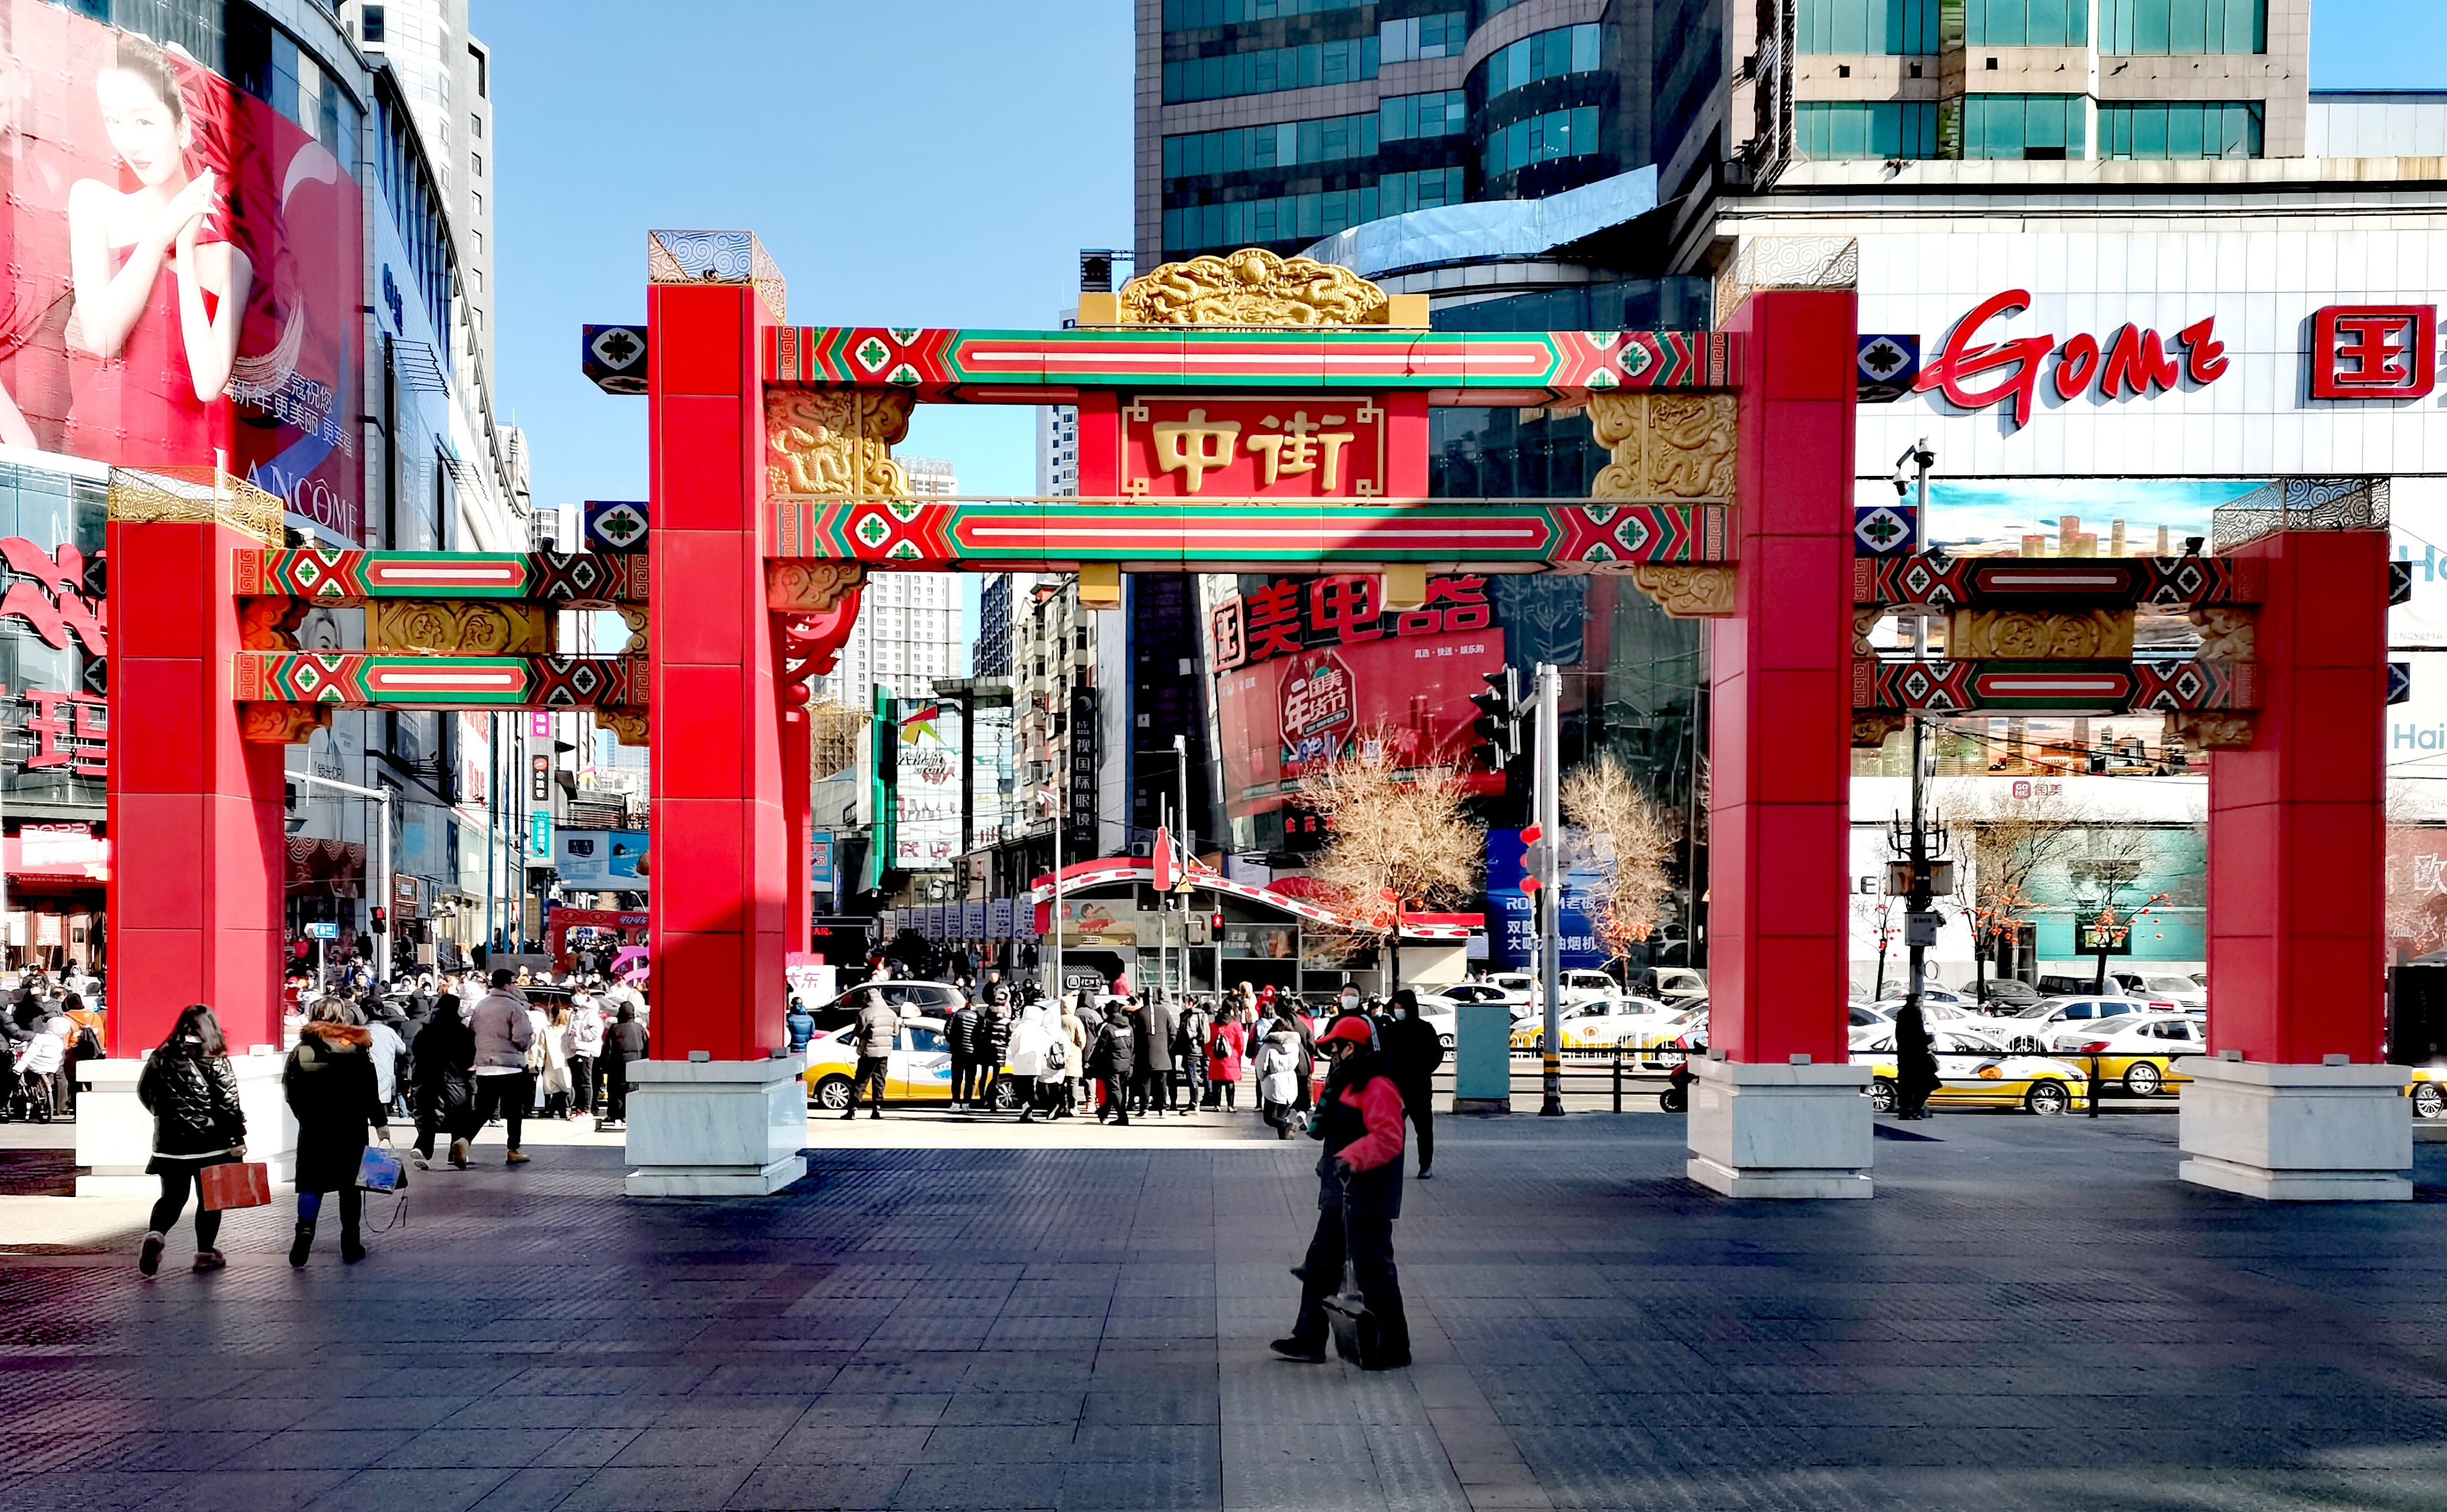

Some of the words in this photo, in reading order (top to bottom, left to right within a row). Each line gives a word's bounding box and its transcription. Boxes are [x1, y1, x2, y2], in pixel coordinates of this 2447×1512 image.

[275, 363, 333, 415] 兰蔻祝您
[231, 374, 318, 437] 新年更美丽
[323, 416, 352, 459] 更幸福
[1153, 408, 1354, 493] 中街
[1309, 669, 1343, 699] 国美
[1285, 687, 1347, 735] 年货节
[1075, 721, 1091, 826] 盛视国际眼镜
[2035, 784, 2063, 796] 国美
